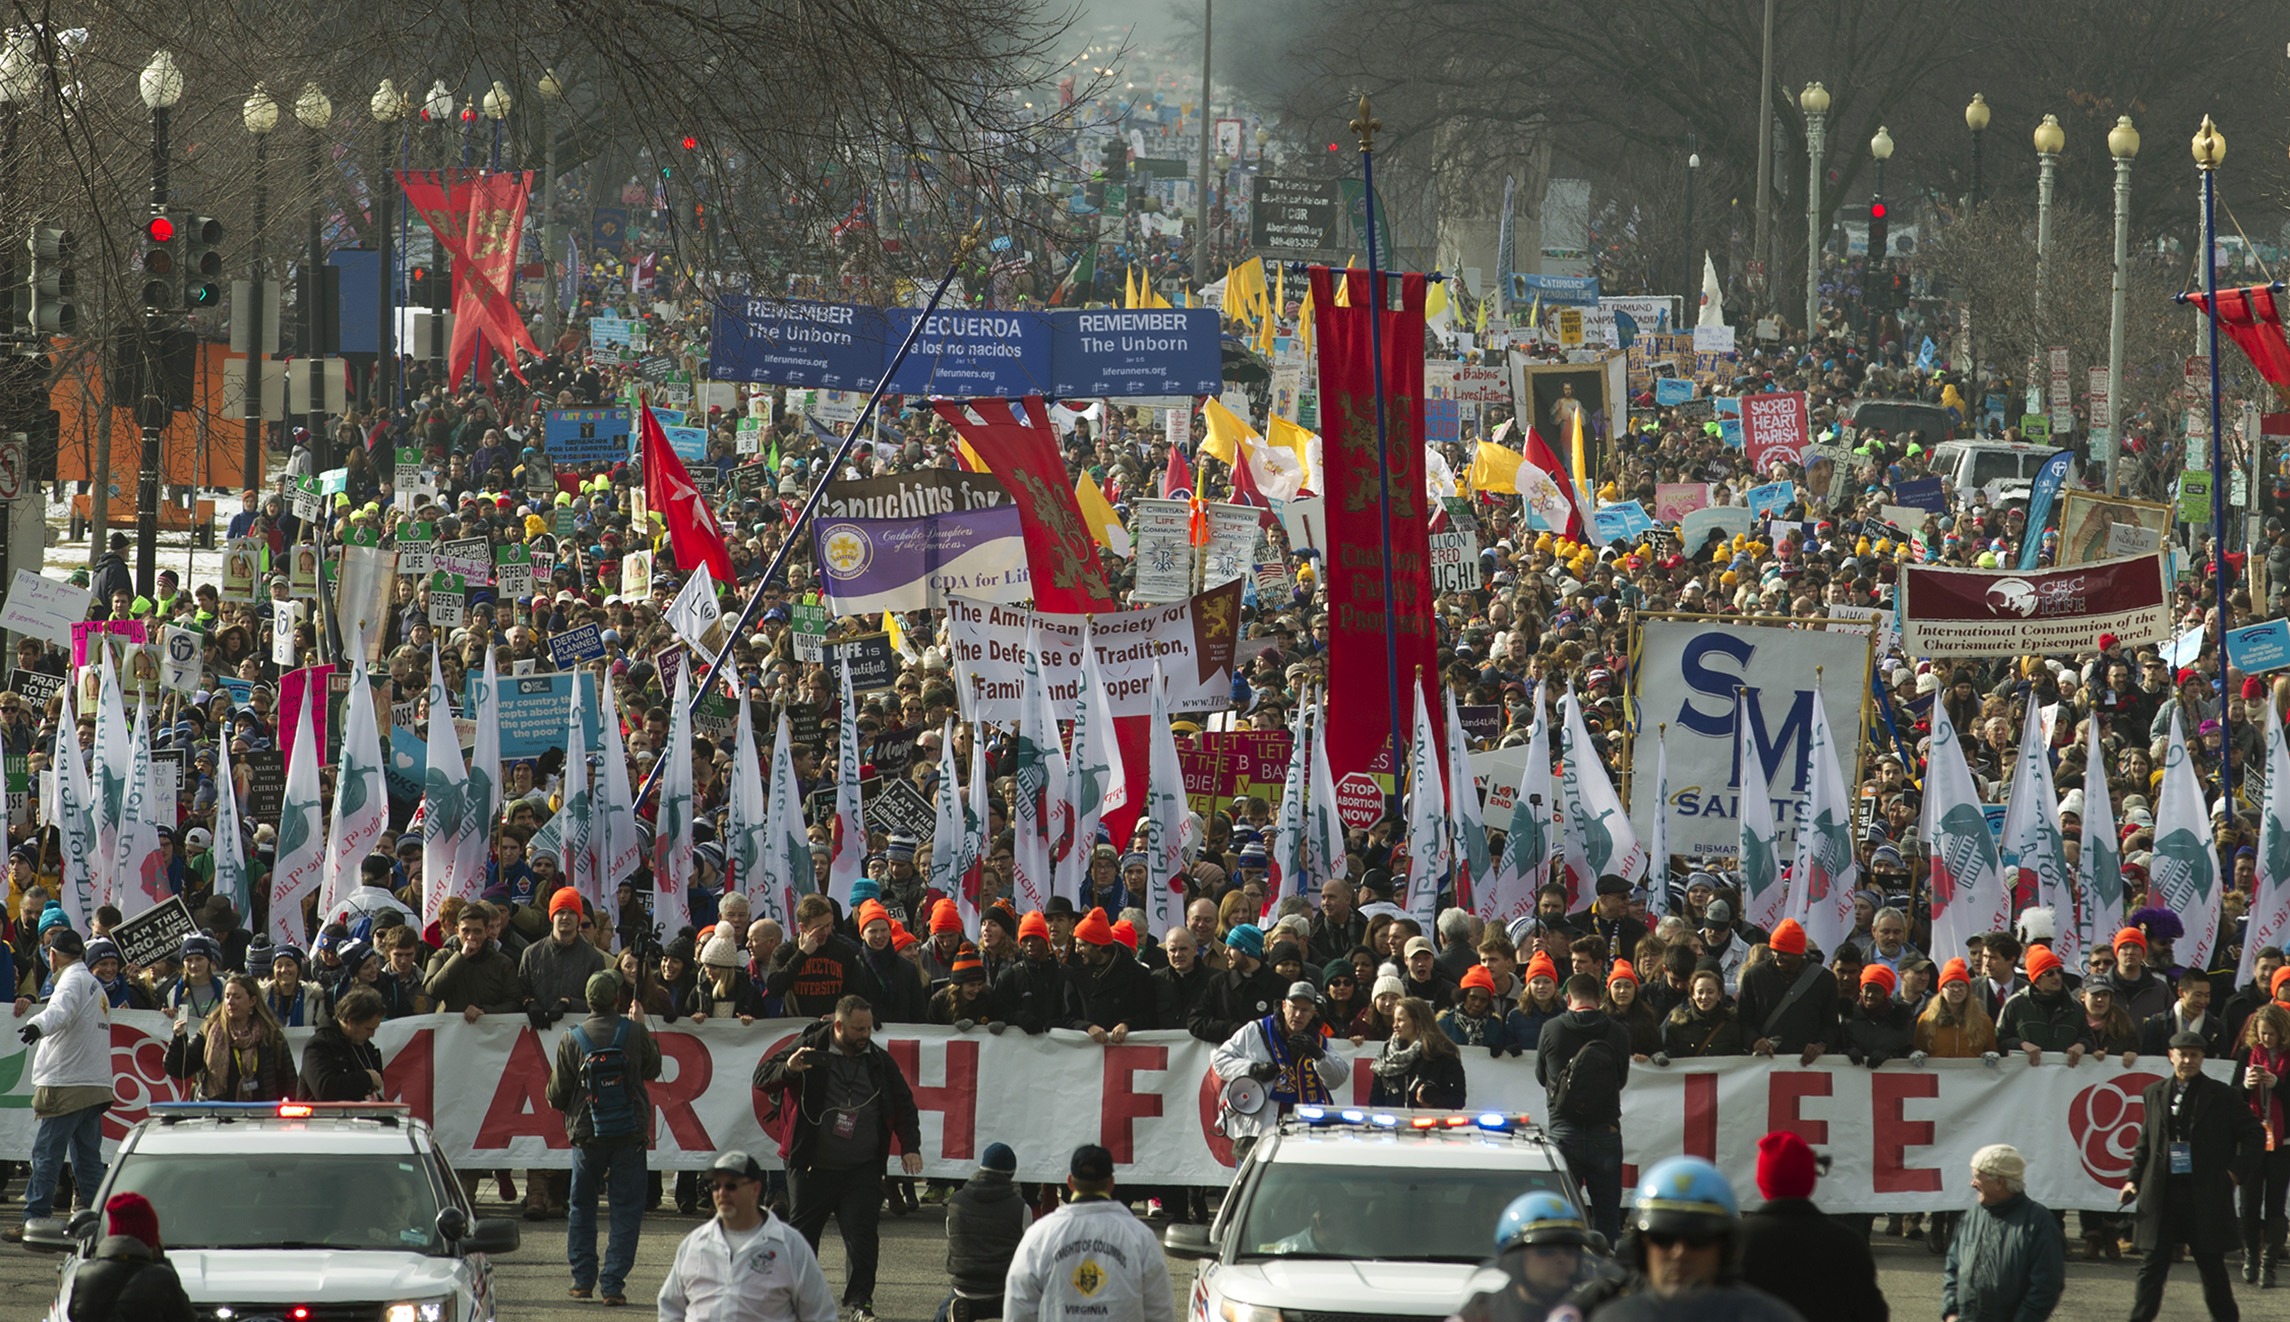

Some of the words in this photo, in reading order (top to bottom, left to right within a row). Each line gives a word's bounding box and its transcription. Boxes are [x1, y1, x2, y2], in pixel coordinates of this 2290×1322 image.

[1540, 277, 1585, 289] CATHOLICS
[1529, 288, 1575, 299] DEFENDING
[1576, 289, 1593, 299] LIFE
[747, 300, 853, 325] REMEMBER
[1611, 303, 1653, 312] EDMUND
[1079, 313, 1188, 332] REMEMBER
[749, 322, 780, 340] The
[787, 326, 852, 346] Unborn
[910, 343, 918, 354] a
[923, 340, 943, 354] los
[948, 344, 964, 356] no
[969, 342, 1022, 358] nacidos
[1081, 337, 1115, 353] The
[1122, 336, 1188, 352] Unborn
[764, 354, 828, 369] liferunners.org
[936, 368, 996, 380] liferunners.org
[1102, 367, 1167, 376] liferunners.org
[672, 392, 684, 402] LIFE
[1446, 401, 1459, 417] IS
[1751, 398, 1797, 415] SACRED
[1752, 414, 1797, 430] HEART
[1754, 428, 1800, 445] PARISH
[740, 441, 753, 451] LIFE
[396, 464, 420, 476] DEFEND
[401, 476, 414, 488] LIFE
[297, 489, 319, 506] DEFEND
[298, 503, 312, 518] LIFE
[1146, 506, 1185, 514] CHRISTIAN
[1215, 512, 1254, 522] CHRISTIAN
[1155, 516, 1175, 525] LIFE
[1223, 522, 1243, 531] LIFE
[882, 529, 923, 542] Catholic
[926, 525, 974, 542] Daughters
[1142, 526, 1187, 534] COMMUNITY
[398, 542, 431, 555] DEFEND
[447, 543, 487, 557] DEFUND
[406, 556, 424, 569] LIFE
[499, 566, 531, 579] DEFEND
[930, 575, 969, 590] CDA
[975, 572, 999, 587] for
[1005, 569, 1029, 585] Lif
[506, 580, 524, 592] LIFE
[2039, 576, 2086, 594] CEC
[431, 593, 464, 607] DEFEND
[2040, 596, 2086, 616] LIFE
[436, 608, 455, 621] LIFE
[793, 605, 809, 621] LOVE
[810, 606, 825, 622] LIFE
[948, 600, 982, 623] The
[989, 605, 1079, 636] American
[1090, 616, 1157, 636] Society
[1162, 604, 1187, 623] for
[1916, 623, 2017, 637] International
[2021, 619, 2113, 636] Communion
[2117, 617, 2134, 633] of
[2136, 613, 2157, 628] the
[553, 628, 595, 648] DEFUND
[796, 633, 823, 650] CHOOSE
[1923, 636, 2018, 653] Charismatic
[2021, 635, 2093, 650] Episcopal
[2112, 626, 2152, 643] hurch
[278, 645, 284, 658] 6
[556, 637, 598, 656] PLANNED
[558, 644, 601, 662] PARENTHOOD
[833, 641, 863, 660] LFE
[955, 639, 982, 661] the
[989, 640, 1062, 666] Defese
[2248, 642, 2274, 652] Families
[803, 648, 817, 661] LIFE
[30, 674, 62, 691] PRAY
[173, 671, 184, 684] 7
[331, 677, 351, 691] LIF
[21, 683, 39, 696] TO
[40, 688, 56, 698] EN
[499, 700, 514, 711] ny
[517, 697, 558, 707] country
[560, 696, 583, 704] tht
[501, 720, 518, 728] the
[521, 718, 561, 728] poorest
[695, 714, 727, 728] CHOOSE
[1462, 718, 1498, 727] tand4Life
[513, 730, 531, 738] the
[794, 733, 822, 742] CHRIST
[1211, 734, 1238, 750] LET
[1258, 743, 1287, 760] LET
[6, 757, 26, 773] LIFE
[255, 764, 281, 772] MARCH
[1197, 756, 1229, 773] THE
[252, 784, 284, 793] CHRIST
[1186, 774, 1222, 791] BIES
[1342, 782, 1377, 796] STOP
[260, 804, 278, 812] LIFE
[1337, 797, 1382, 809] ABORTION
[1490, 797, 1512, 809] END
[1677, 793, 1812, 822] SAITS
[881, 794, 931, 840] PRO-LIFE
[898, 797, 914, 811] AM
[917, 810, 935, 828] THE
[1342, 809, 1375, 823] NOW
[1694, 843, 1738, 855] BISMAR
[122, 938, 128, 946] I
[133, 925, 152, 941] AM
[154, 909, 180, 928] THE
[124, 916, 191, 960] PRO-LIFE
[132, 930, 196, 966] GENERATIO
[1622, 1071, 1943, 1193] IFE
[1082, 1240, 1092, 1252] OF
[1065, 1305, 1108, 1316] VIRGINIA
